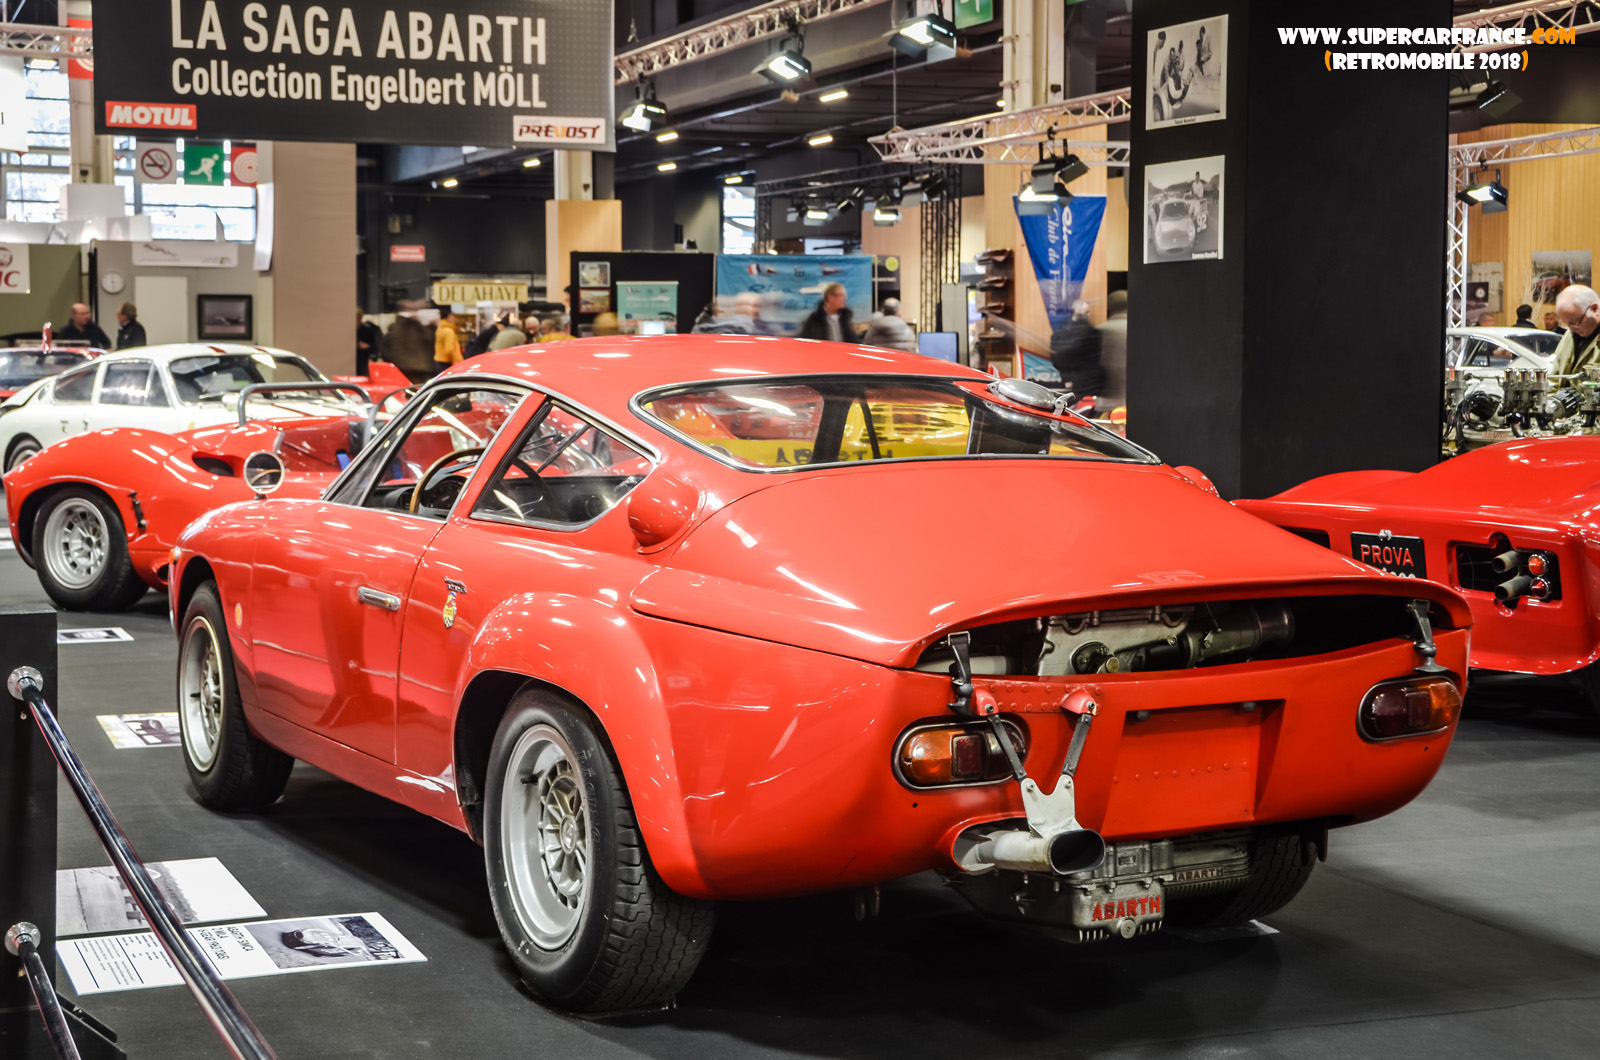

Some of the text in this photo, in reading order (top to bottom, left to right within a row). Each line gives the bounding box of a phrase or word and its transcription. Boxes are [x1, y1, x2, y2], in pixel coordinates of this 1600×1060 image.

[171, 0, 546, 65] LA SAGA ABARTH
[172, 57, 547, 111] Collection Engelbert MÖLL
[109, 105, 193, 126] MOTUL
[1196, 213, 1207, 233] 92
[439, 285, 520, 302] DELAHAYE
[1361, 544, 1414, 567] PROVA
[1178, 867, 1224, 882] ABARTH
[1091, 895, 1161, 922] ABARTH
